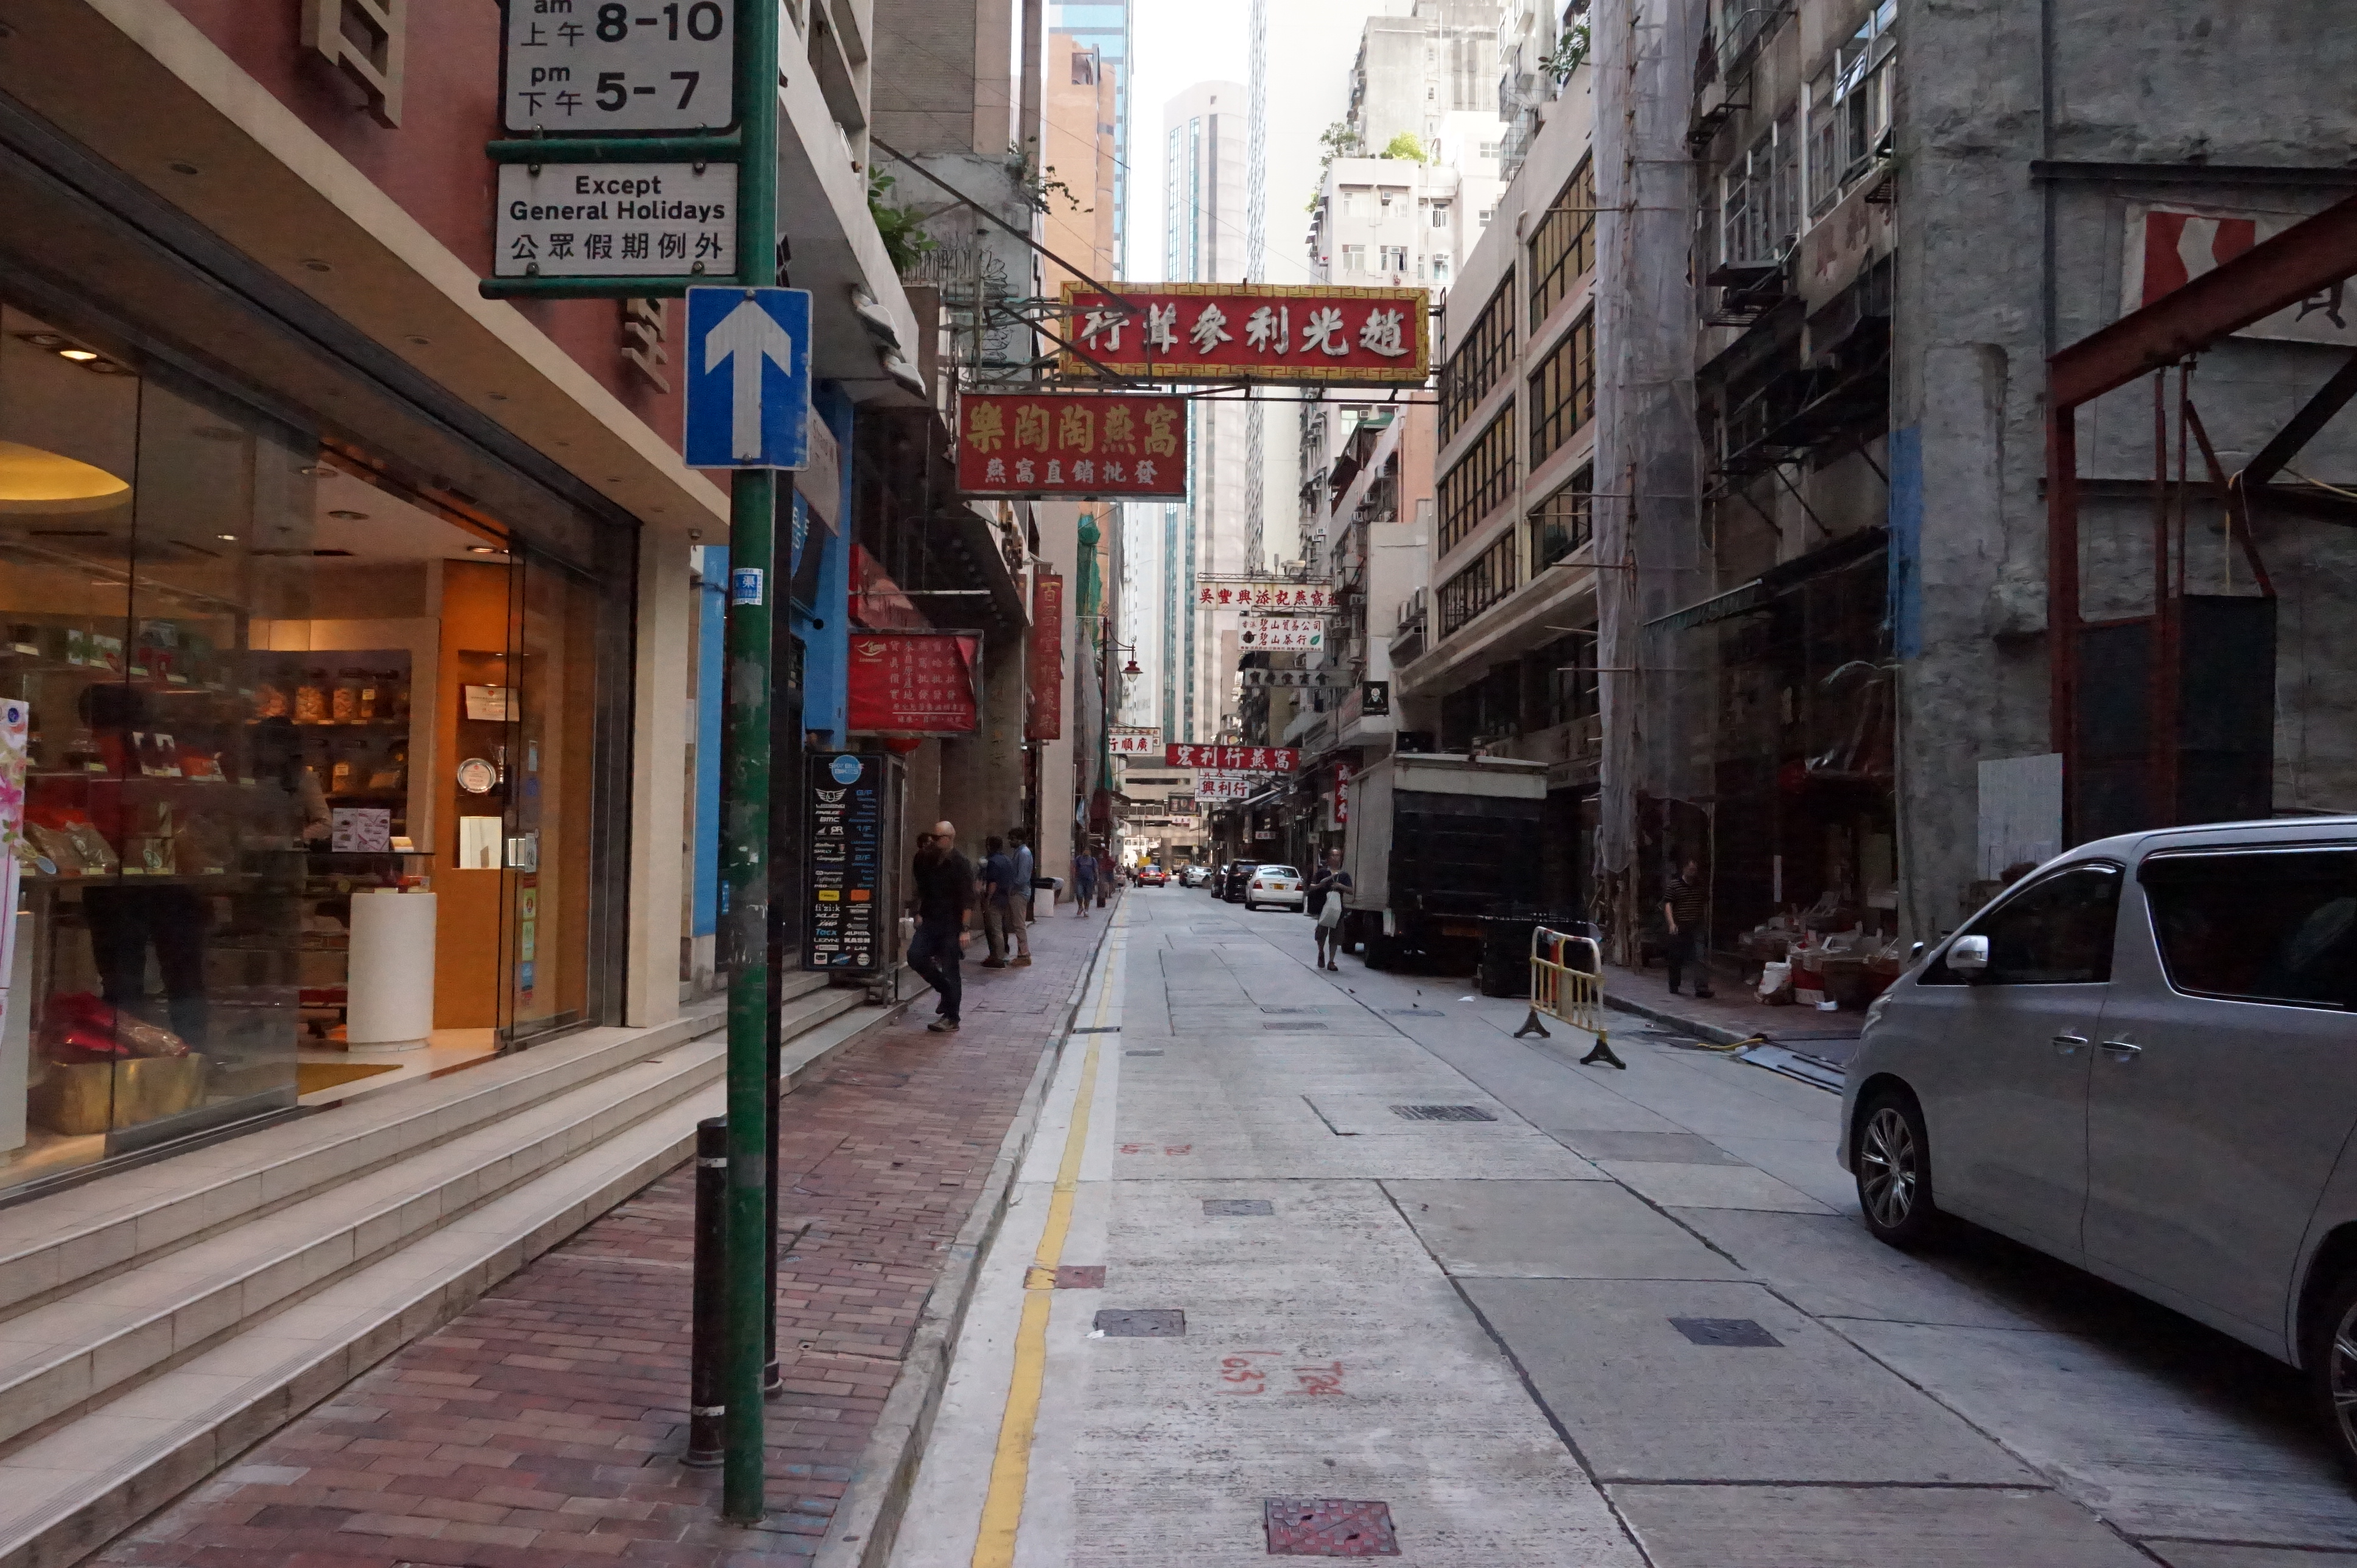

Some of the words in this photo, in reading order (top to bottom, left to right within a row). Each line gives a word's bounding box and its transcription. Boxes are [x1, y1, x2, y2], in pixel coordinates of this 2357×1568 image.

[534, 0, 572, 13] am
[596, 1, 723, 42] 8-10
[520, 22, 584, 46] 上午
[531, 66, 570, 86] pm
[519, 91, 583, 116] 下午
[576, 175, 662, 197] Except
[510, 201, 608, 220] General
[617, 201, 725, 223] Holidays
[511, 233, 723, 260] 公眾假期例外
[966, 401, 1178, 457] 樂陶陶燕窩
[985, 458, 1158, 485] 燕窩直銷批發
[1259, 618, 1321, 632] 碧山貿易公司
[1259, 632, 1307, 645] 碧山茶行
[1176, 745, 1291, 770] 宏利行燕窩
[1200, 780, 1248, 797] 興利行
